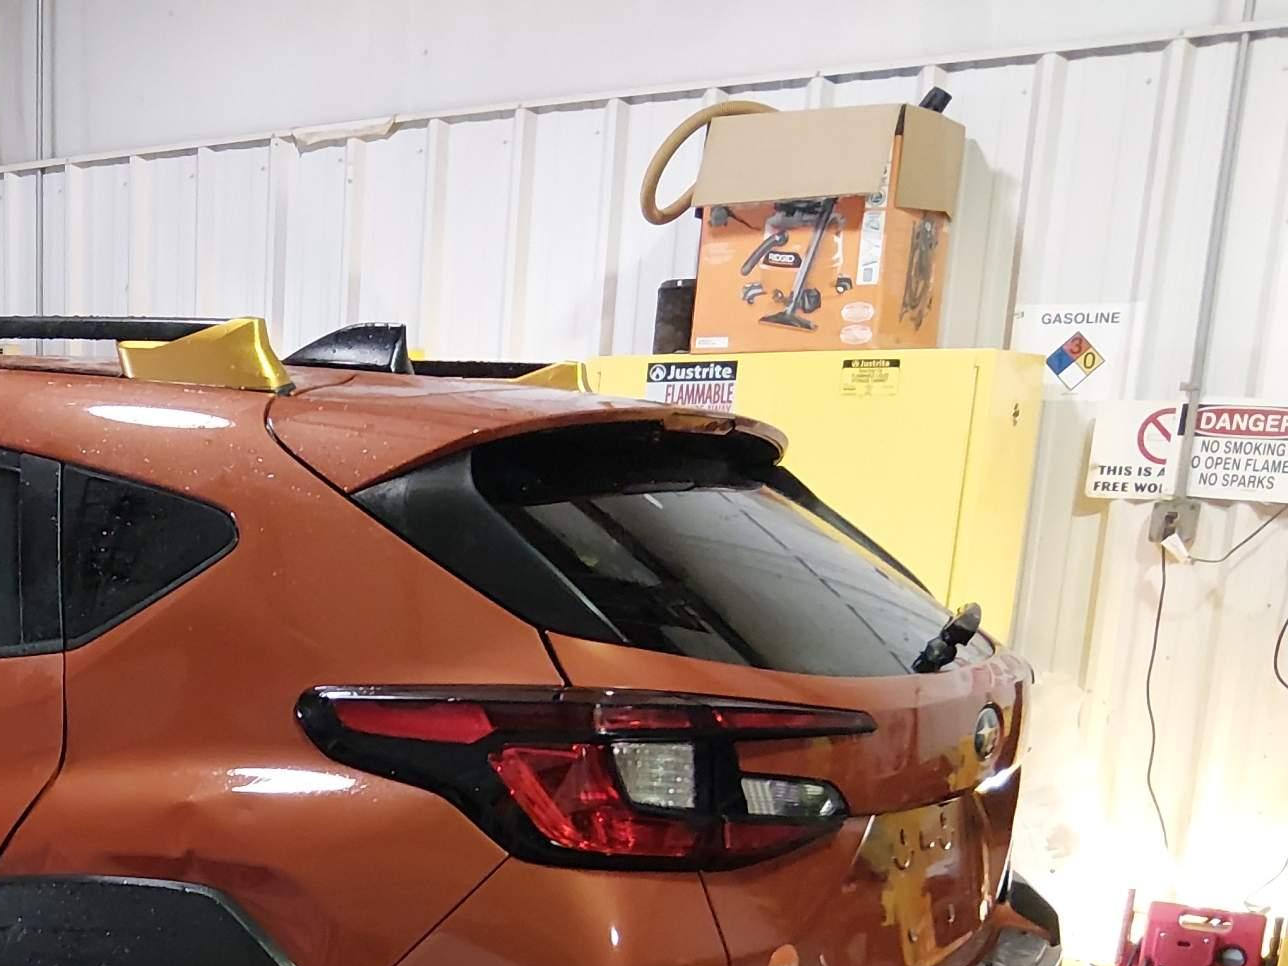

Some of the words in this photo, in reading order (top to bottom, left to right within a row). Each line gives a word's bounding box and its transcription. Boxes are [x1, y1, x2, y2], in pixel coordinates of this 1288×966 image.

[1041, 311, 1121, 325] GASOLINE
[1069, 337, 1083, 355] 3
[1083, 351, 1096, 369] 0
[666, 363, 732, 381] Justrite
[665, 383, 734, 405] FLAMMABLE
[1200, 439, 1220, 453] NO
[1223, 440, 1287, 457] SMOKING
[1098, 465, 1133, 477] THIS
[1137, 466, 1153, 477] IS
[1204, 455, 1241, 471] OPEN
[1093, 481, 1130, 493] FREE
[1198, 472, 1218, 486] NO
[1221, 473, 1276, 490] SPARKS
